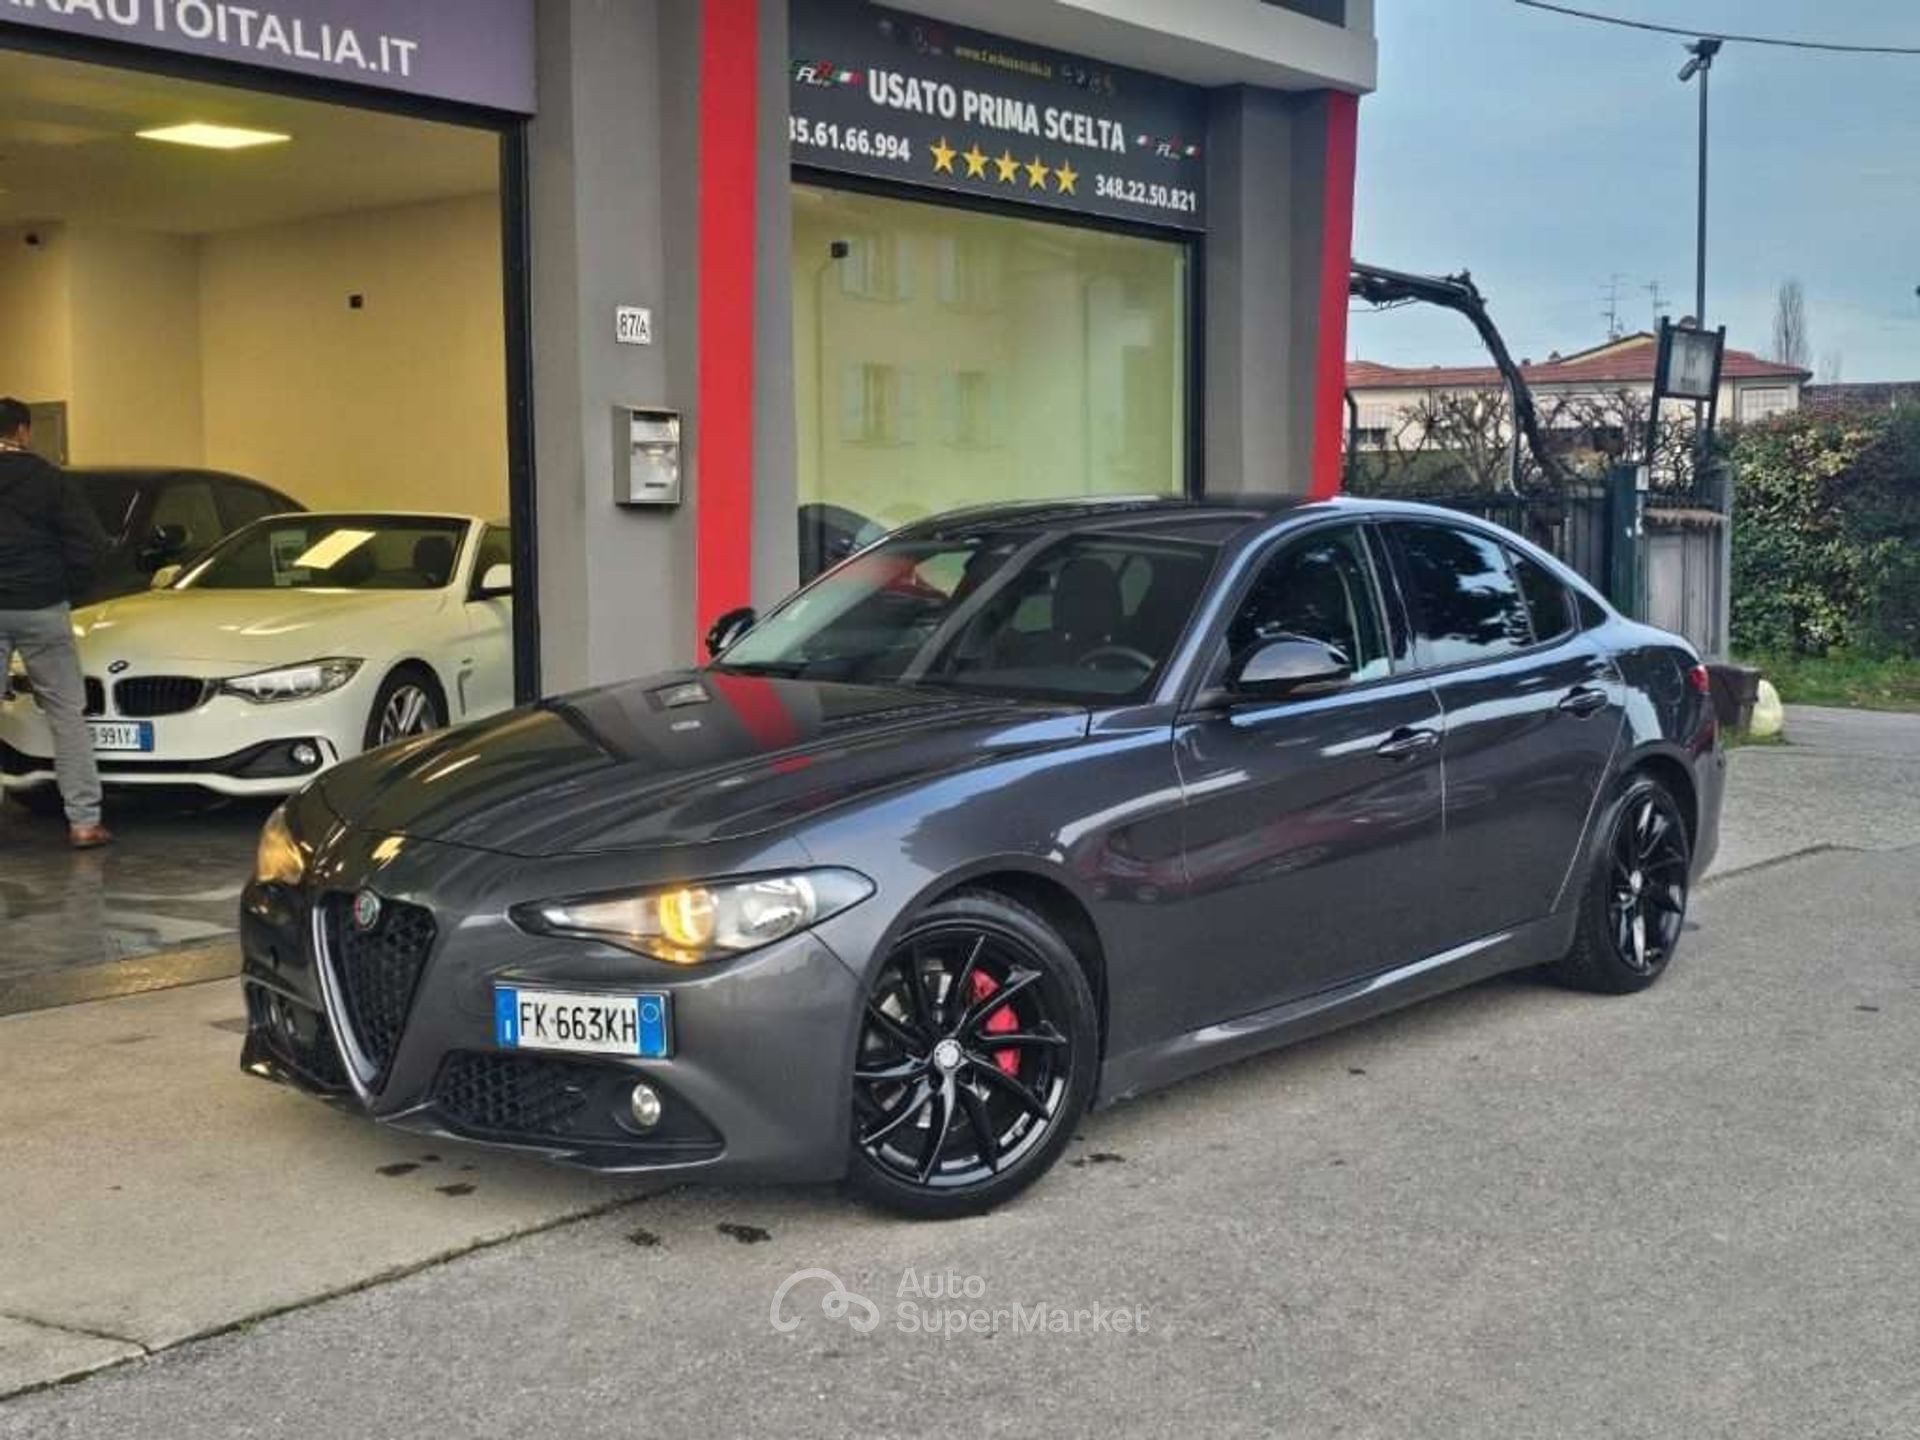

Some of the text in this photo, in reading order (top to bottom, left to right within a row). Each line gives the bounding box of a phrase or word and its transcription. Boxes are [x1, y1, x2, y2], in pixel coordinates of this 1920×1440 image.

[868, 68, 957, 119] USATO
[962, 90, 1040, 136] PRIMA
[1044, 107, 1126, 154] SCELTA
[1095, 173, 1197, 212] 348.22.50.821
[619, 313, 648, 338] 87/A
[520, 1002, 548, 1037] FK
[556, 1006, 638, 1044] 663KH
